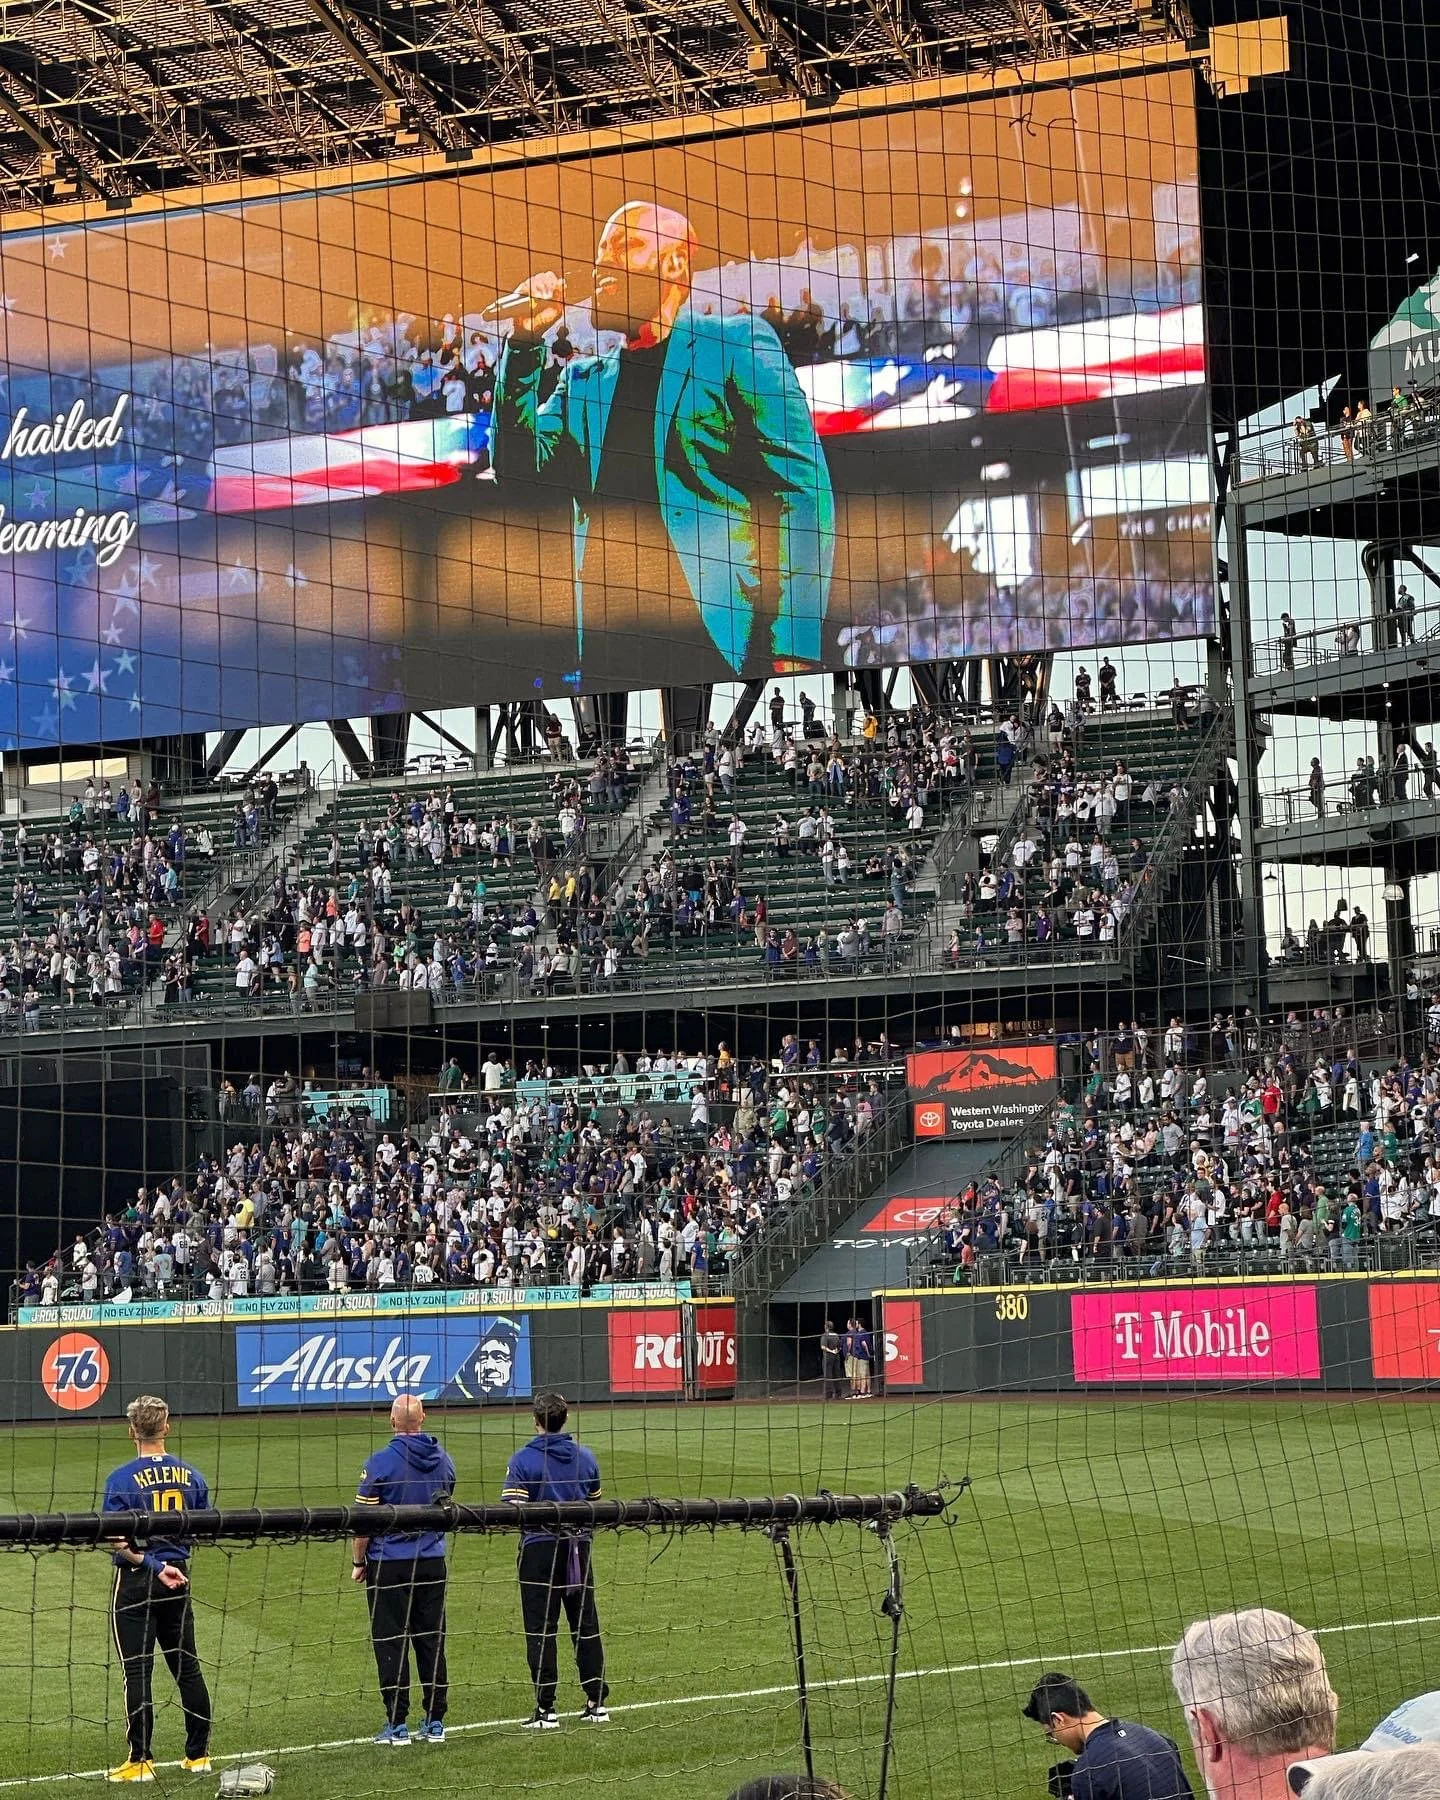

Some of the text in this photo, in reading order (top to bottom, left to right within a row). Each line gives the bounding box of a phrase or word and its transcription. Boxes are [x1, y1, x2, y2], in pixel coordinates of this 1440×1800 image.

[2, 393, 130, 459] hailed
[950, 1102, 1048, 1117] Western Washingto
[951, 1116, 1024, 1132] Toyota Dealers
[104, 1308, 117, 1318] NO
[119, 1307, 134, 1317] FLY
[135, 1306, 160, 1316] ZONE
[245, 1303, 258, 1312] NO
[261, 1302, 275, 1311] FLY
[389, 1296, 402, 1306] NO
[405, 1296, 421, 1305] FLY
[422, 1295, 447, 1305] ZONE
[537, 1291, 551, 1301] NO
[553, 1290, 570, 1300] FLY
[571, 1290, 597, 1299] ZE
[995, 1294, 1028, 1321] 380
[1150, 1308, 1270, 1359] Mobile
[53, 1347, 100, 1393] 76
[250, 1335, 431, 1396] Alaska
[132, 1466, 192, 1489] KELENIC
